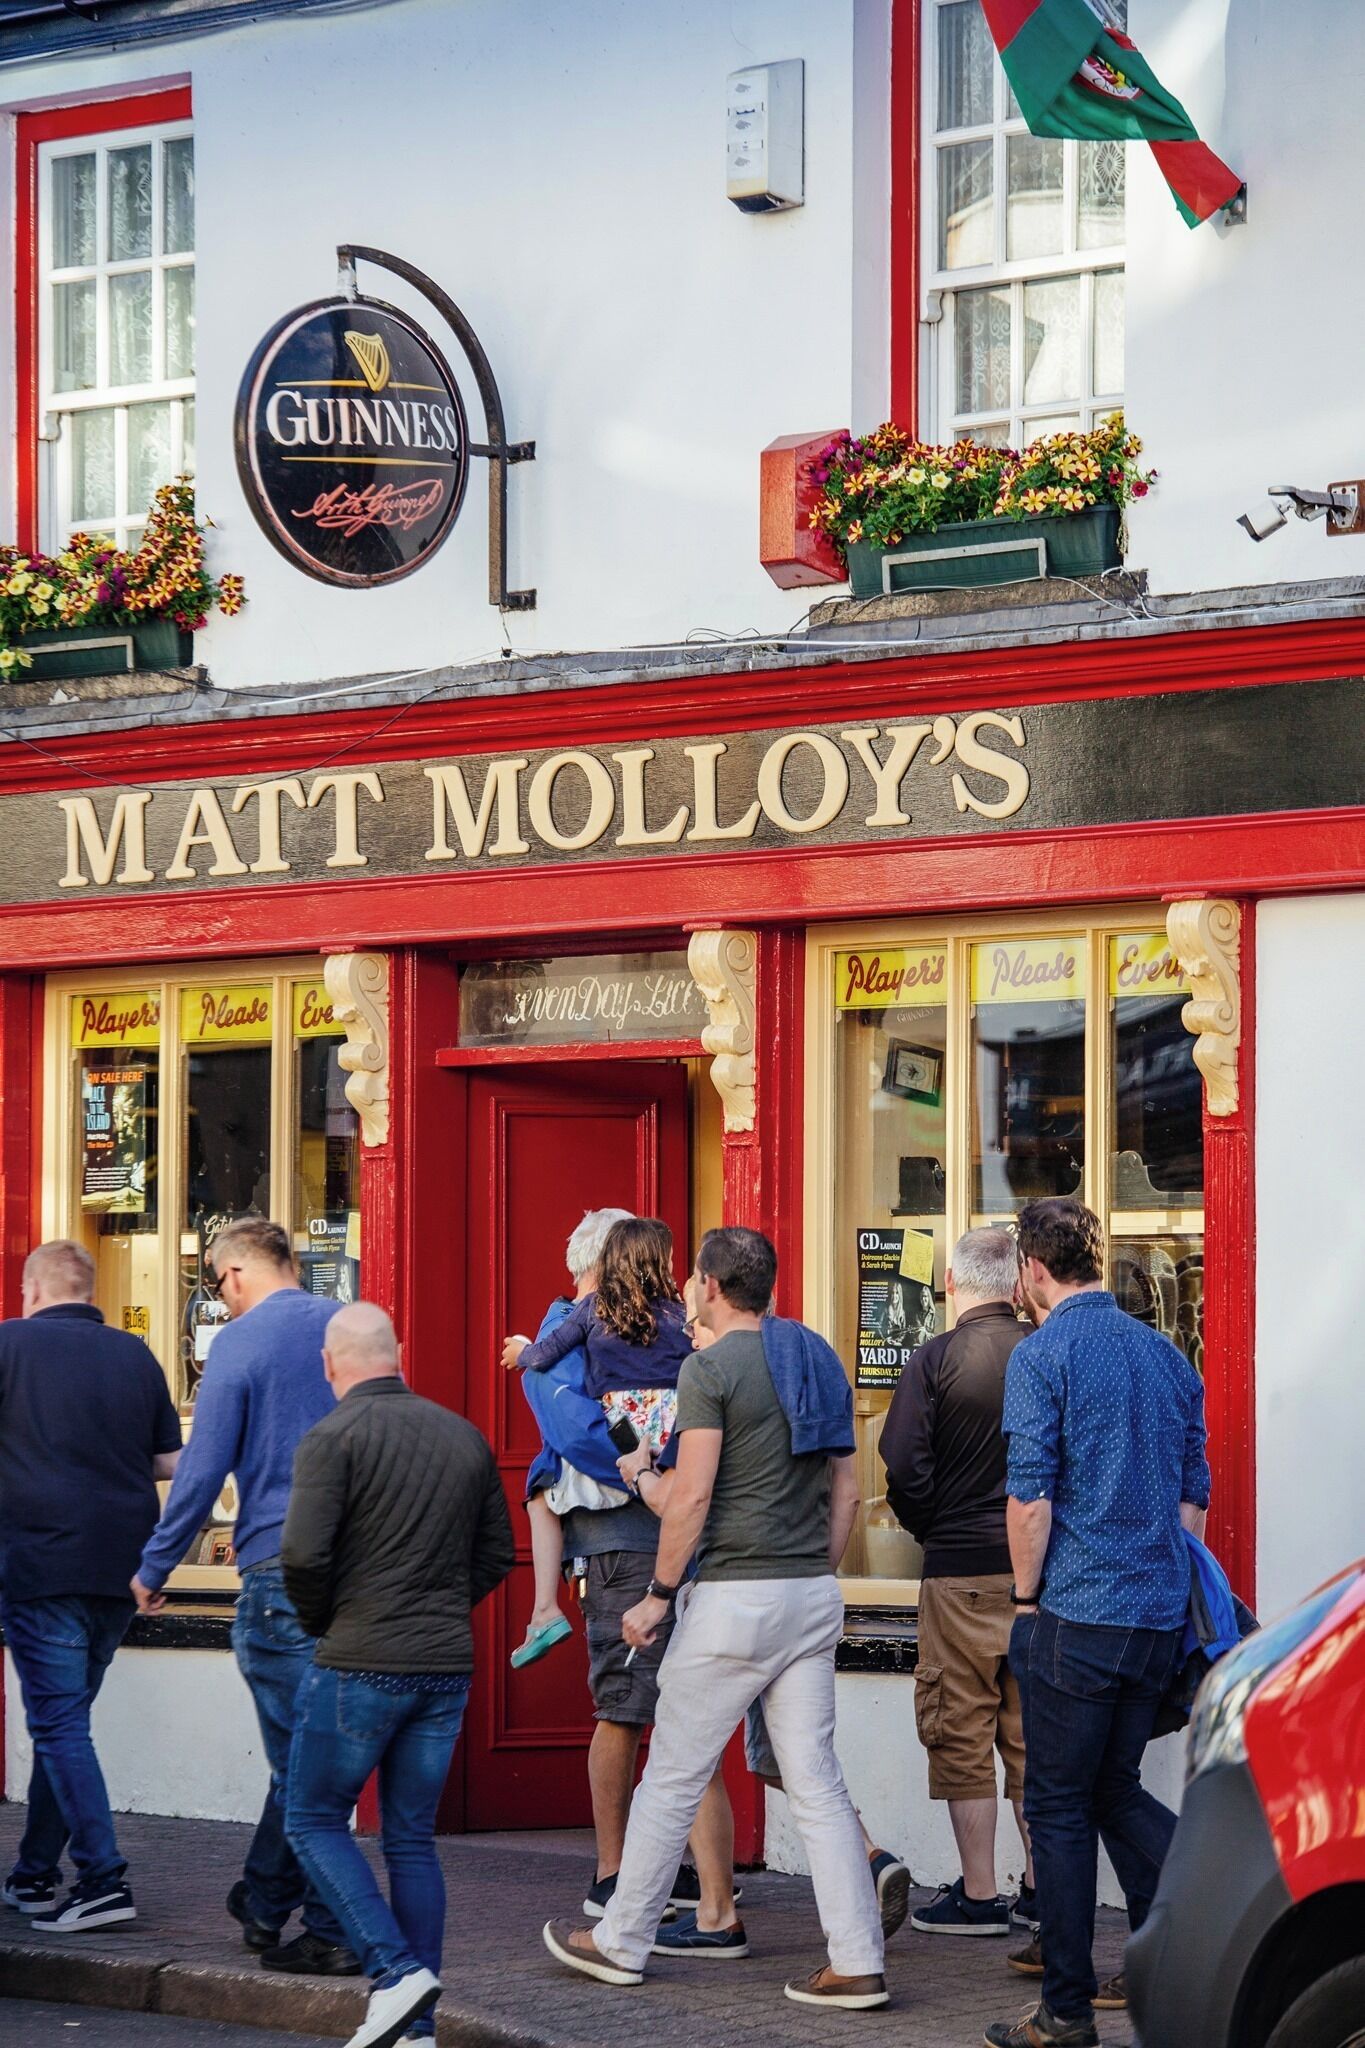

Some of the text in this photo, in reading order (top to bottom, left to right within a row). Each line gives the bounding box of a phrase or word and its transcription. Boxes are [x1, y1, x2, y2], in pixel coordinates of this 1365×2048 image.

[266, 390, 459, 451] GUINNESS
[58, 711, 1030, 887] MATT MOLLOY'S
[844, 955, 945, 1002] Player's
[990, 947, 1076, 996] Please
[80, 999, 160, 1042] Player's
[200, 991, 268, 1036] Please
[300, 990, 334, 1028] Eve
[101, 1072, 121, 1083] SALE
[122, 1071, 143, 1082] HERE
[310, 1219, 327, 1235] CD
[860, 1233, 880, 1250] CD
[880, 1242, 902, 1250] LAUNCH
[125, 1312, 146, 1330] GLOBE
[859, 1348, 916, 1366] YARD B
[858, 1367, 893, 1377] THURSDAY,
